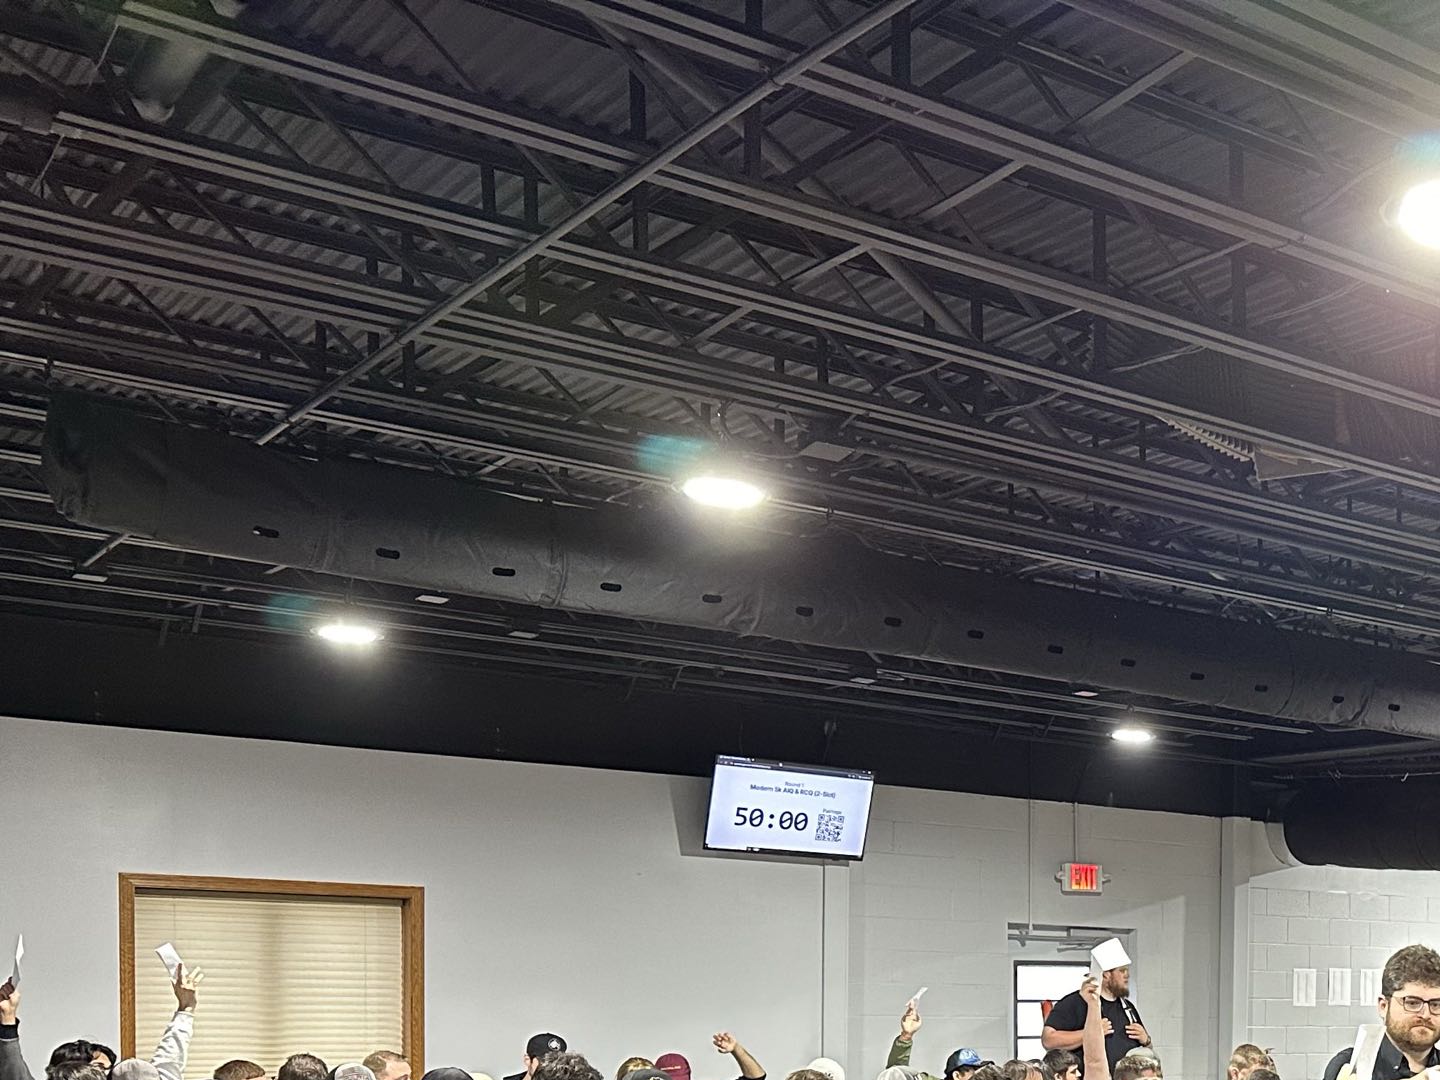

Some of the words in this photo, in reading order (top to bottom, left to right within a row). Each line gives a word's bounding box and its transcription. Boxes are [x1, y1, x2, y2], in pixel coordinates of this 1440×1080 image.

[749, 784, 774, 792] Modern
[733, 806, 809, 831] 50:00
[1071, 863, 1099, 890] EXIT
